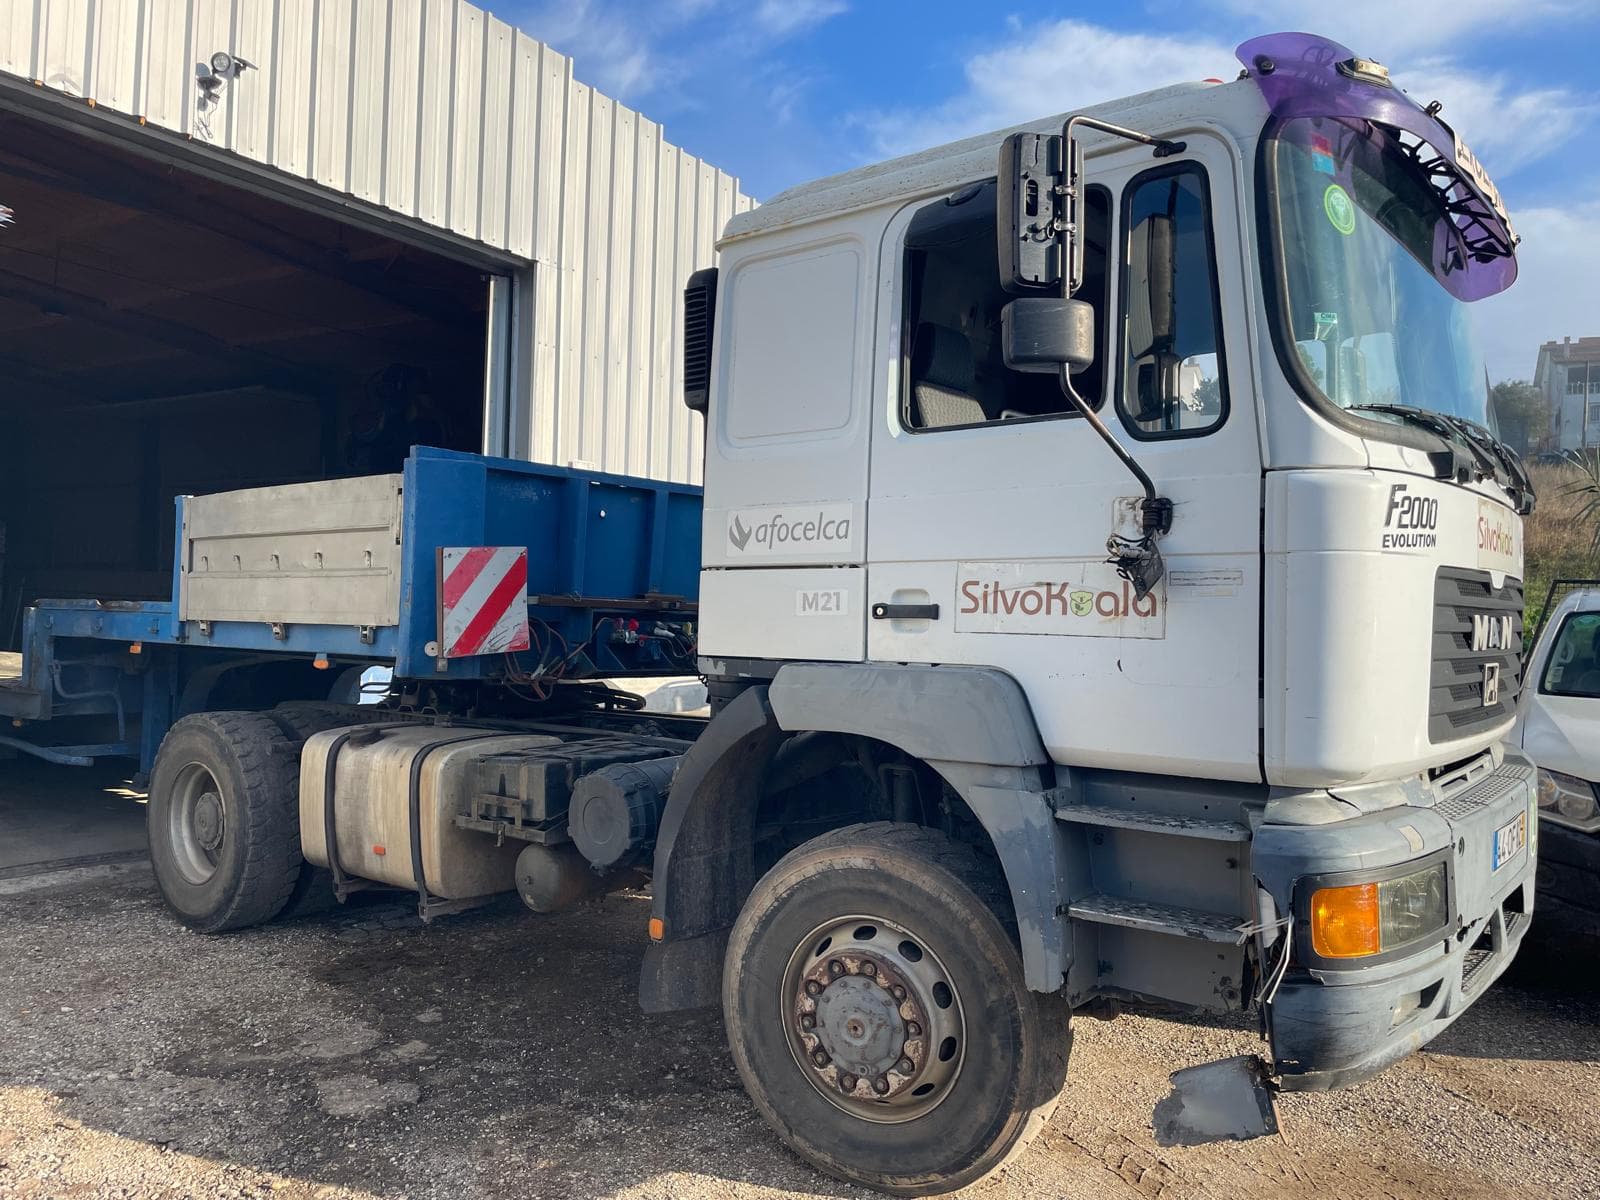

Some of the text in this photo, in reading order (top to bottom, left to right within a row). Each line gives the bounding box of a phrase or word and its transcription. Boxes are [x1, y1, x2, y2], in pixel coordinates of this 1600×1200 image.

[1384, 484, 1438, 530] F2000
[755, 511, 850, 550] afocelca
[1382, 533, 1437, 549] EVOLUTION
[801, 591, 841, 612] M21
[1473, 614, 1513, 651] MAN
